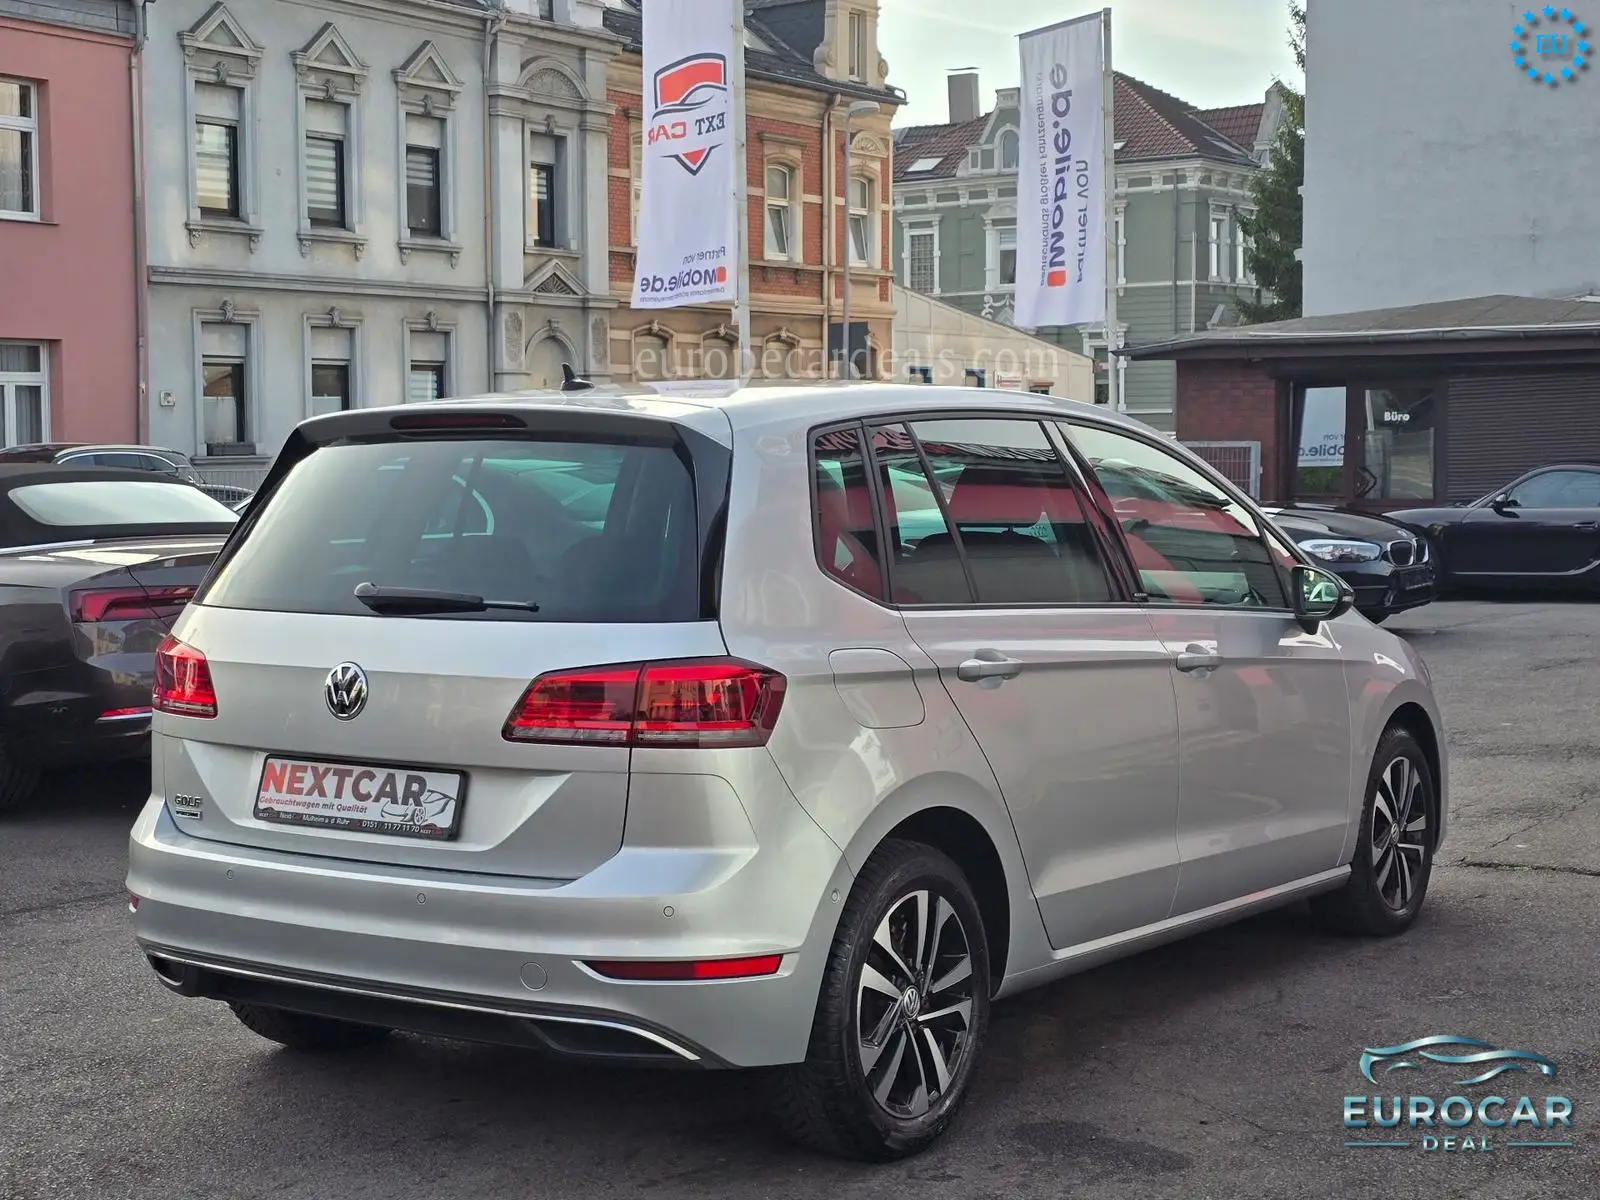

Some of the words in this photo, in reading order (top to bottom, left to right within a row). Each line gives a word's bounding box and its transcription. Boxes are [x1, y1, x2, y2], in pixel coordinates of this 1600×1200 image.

[1384, 411, 1410, 421] Büro
[261, 762, 428, 807] NEXTCAR
[175, 793, 201, 807] GOLF
[259, 796, 321, 809] Gebrauchtwagen
[322, 801, 334, 810] mit
[336, 803, 368, 814] Qualität
[362, 820, 378, 829] 0151
